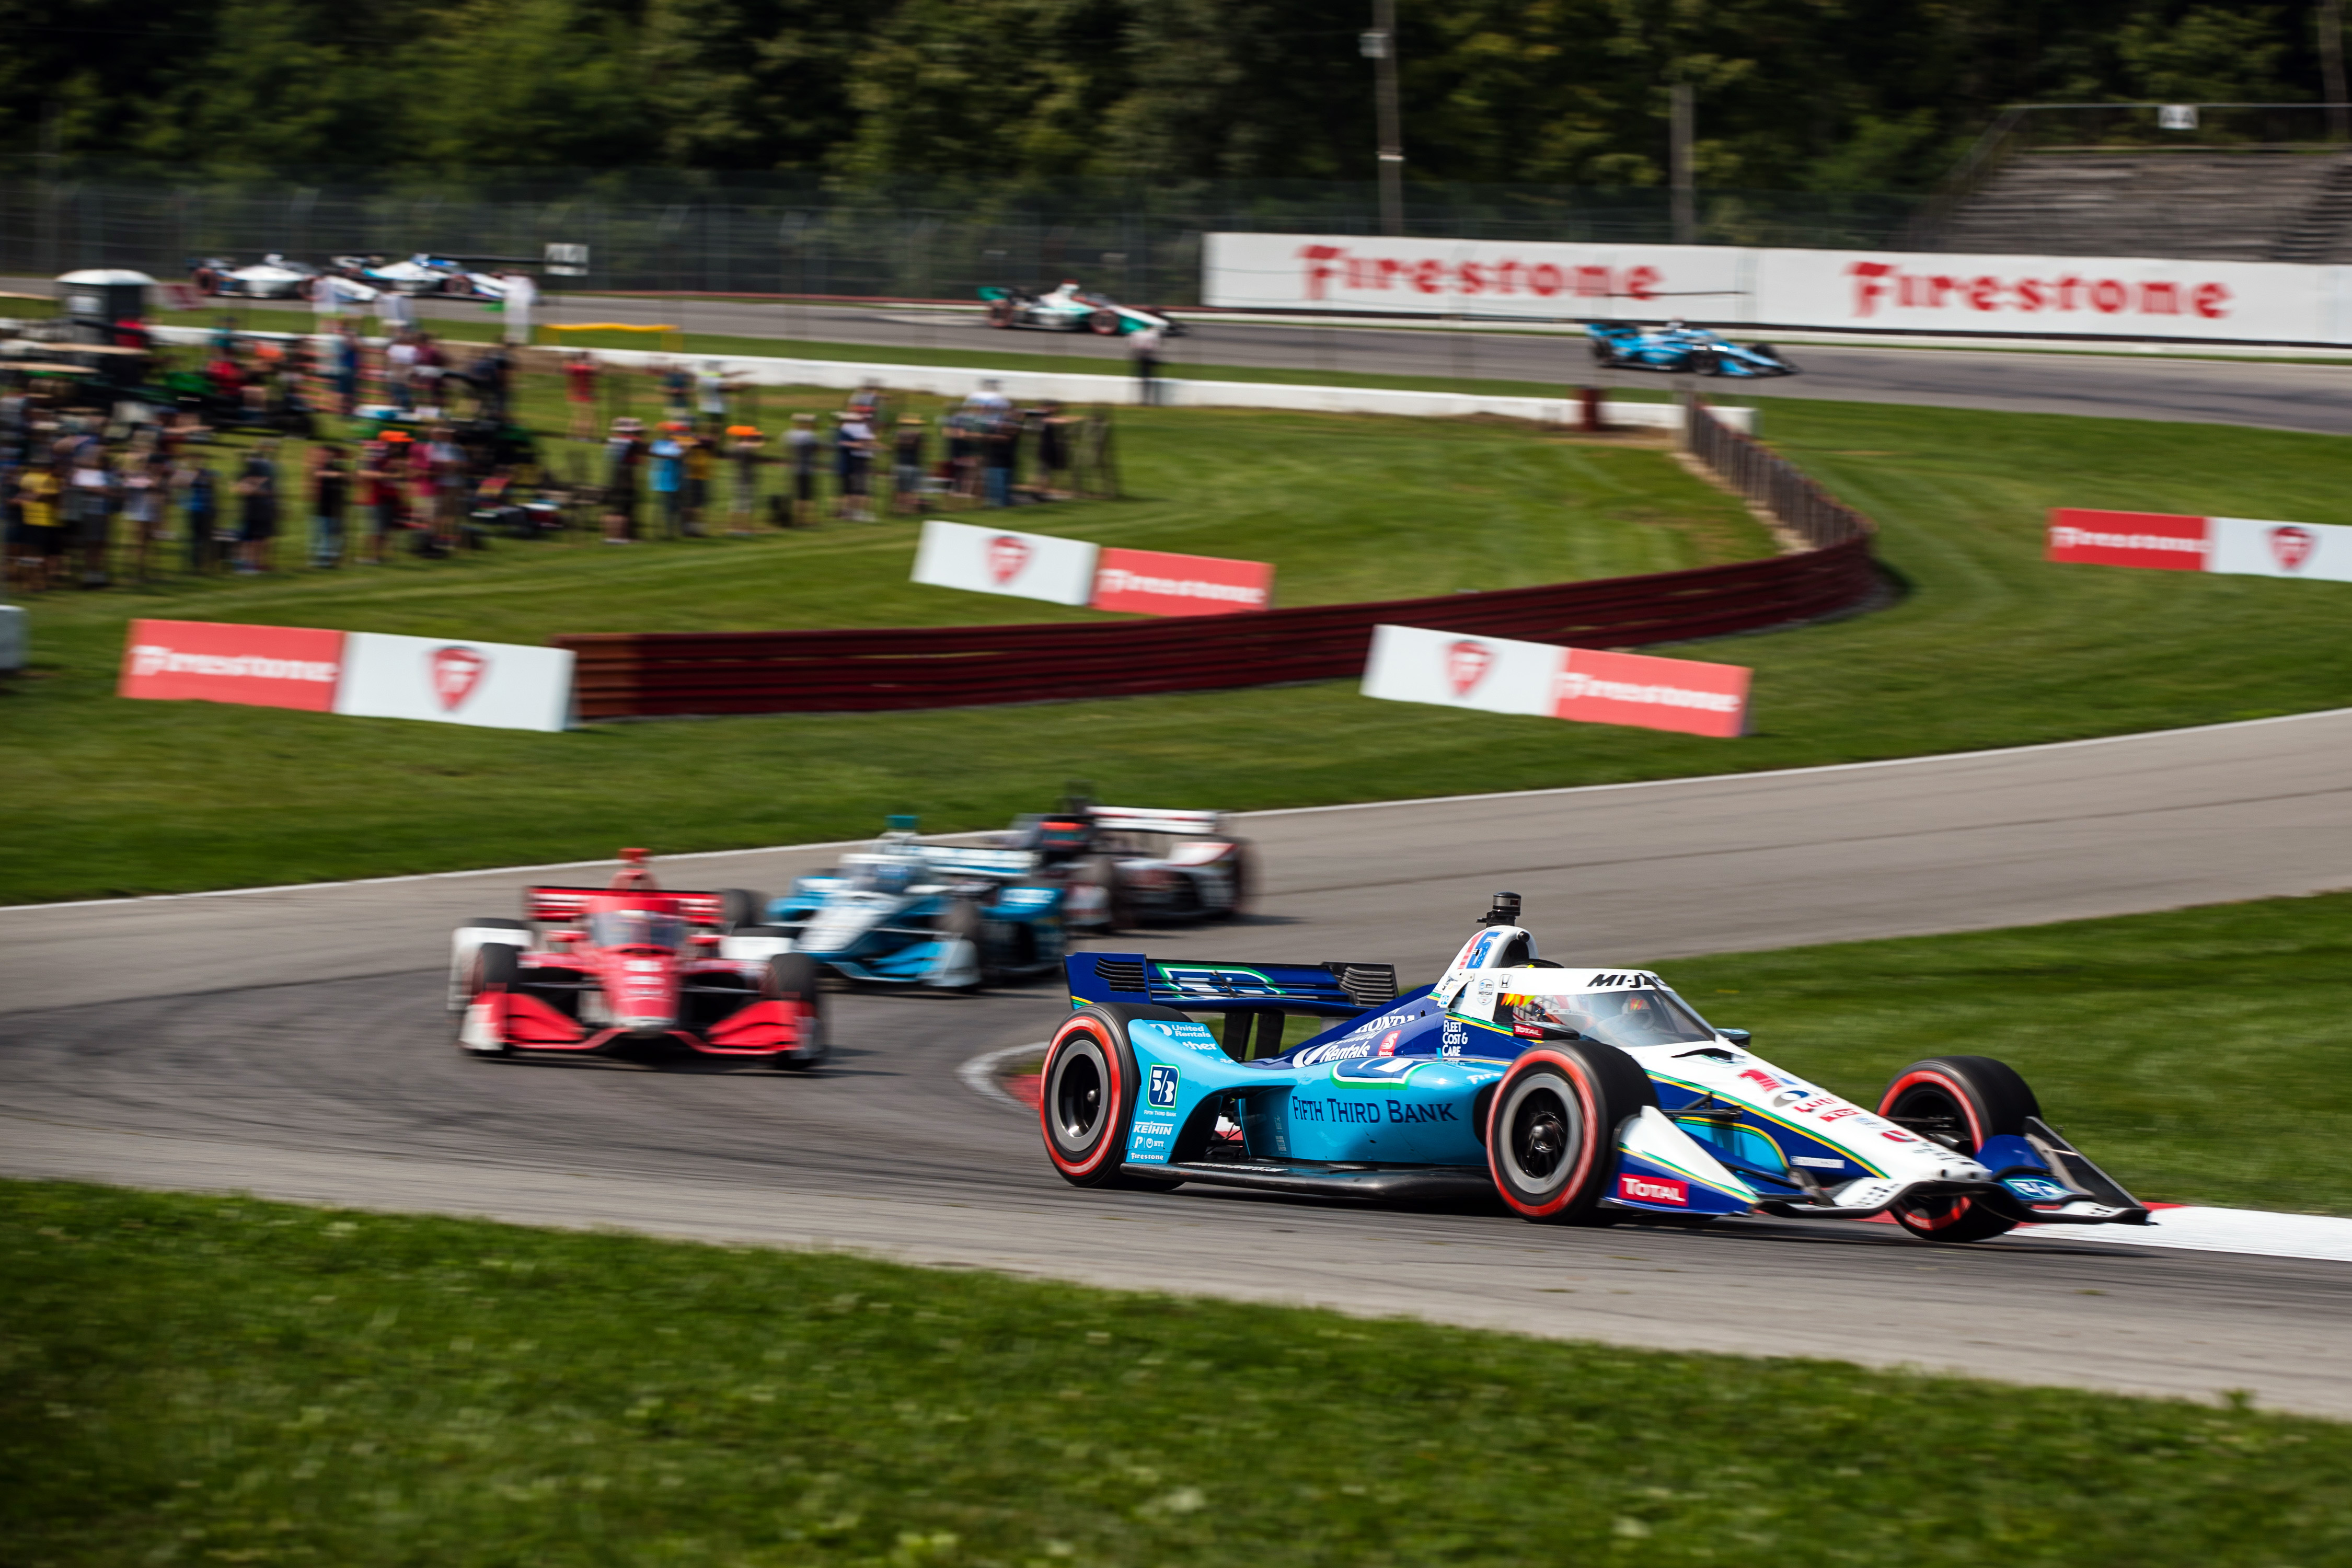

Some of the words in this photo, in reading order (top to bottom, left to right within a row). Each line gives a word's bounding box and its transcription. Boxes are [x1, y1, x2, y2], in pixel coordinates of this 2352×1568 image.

[1296, 245, 1664, 300] Firestone
[1845, 261, 2234, 319] Firestone
[1443, 1020, 1462, 1032] FLEET
[1442, 1032, 1461, 1044] COST
[1461, 1032, 1468, 1044] &
[1319, 1041, 1370, 1063] Rentals
[1442, 1044, 1461, 1056] CARE
[1292, 1096, 1324, 1121] FIFTH
[1327, 1098, 1380, 1123] THIRD
[1386, 1100, 1459, 1123] BANK
[1133, 1124, 1172, 1135] KEIHIN
